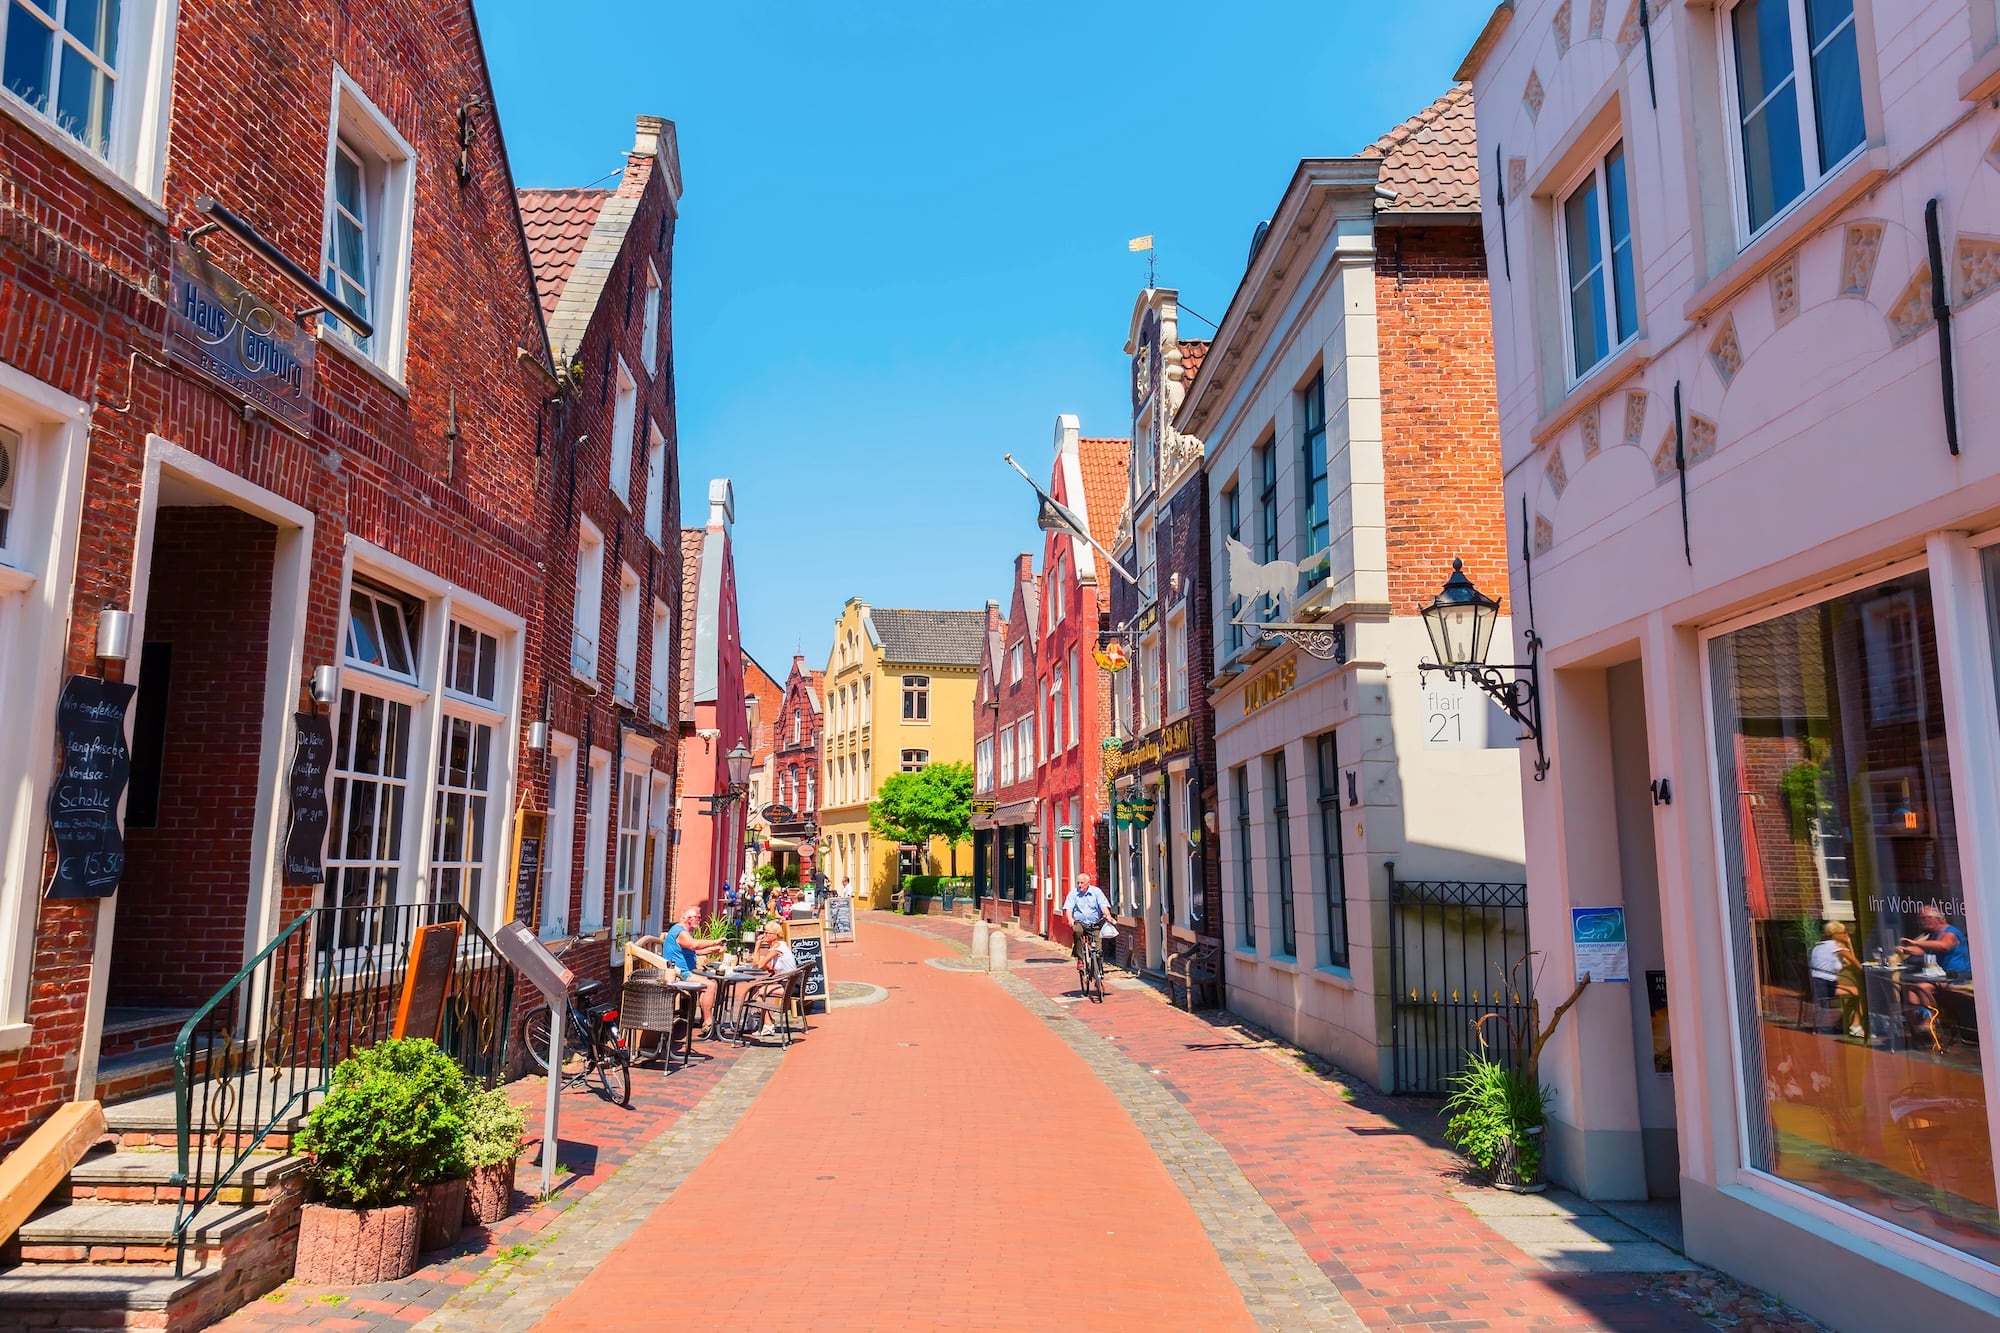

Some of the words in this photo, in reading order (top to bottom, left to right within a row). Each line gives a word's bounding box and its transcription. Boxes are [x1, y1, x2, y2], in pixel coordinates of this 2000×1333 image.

[185, 282, 227, 338] Haus
[197, 291, 302, 398] Hamburg
[200, 355, 288, 415] RESTAURANT
[1428, 692, 1464, 711] flair
[1430, 713, 1461, 742] 21
[60, 785, 110, 808] Scholle
[1650, 778, 1672, 806] 14
[1868, 894, 1885, 912] Ihr
